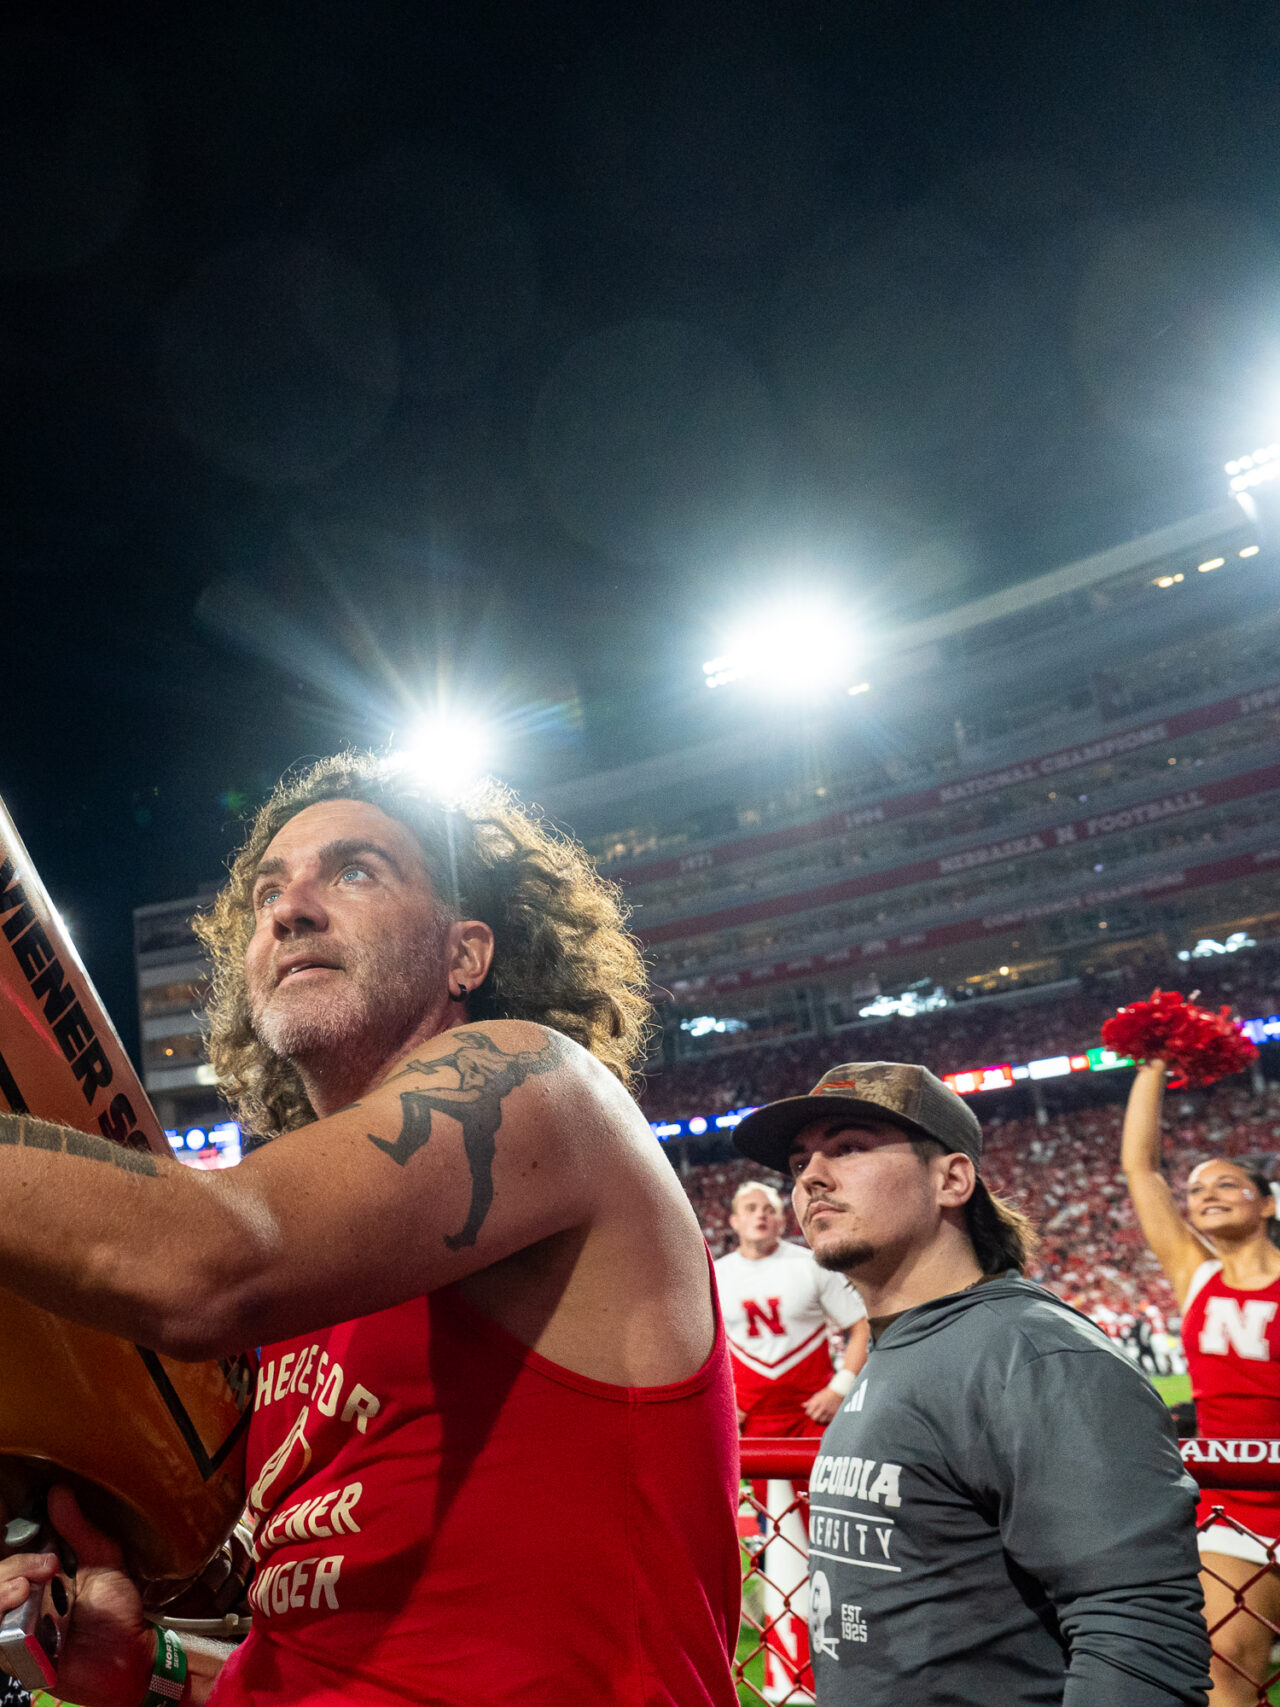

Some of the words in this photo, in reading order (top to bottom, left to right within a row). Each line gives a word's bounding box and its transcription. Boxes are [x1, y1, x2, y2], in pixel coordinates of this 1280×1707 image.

[743, 1297, 786, 1337] N
[1199, 1296, 1279, 1361] N
[841, 1621, 868, 1643] 1925
